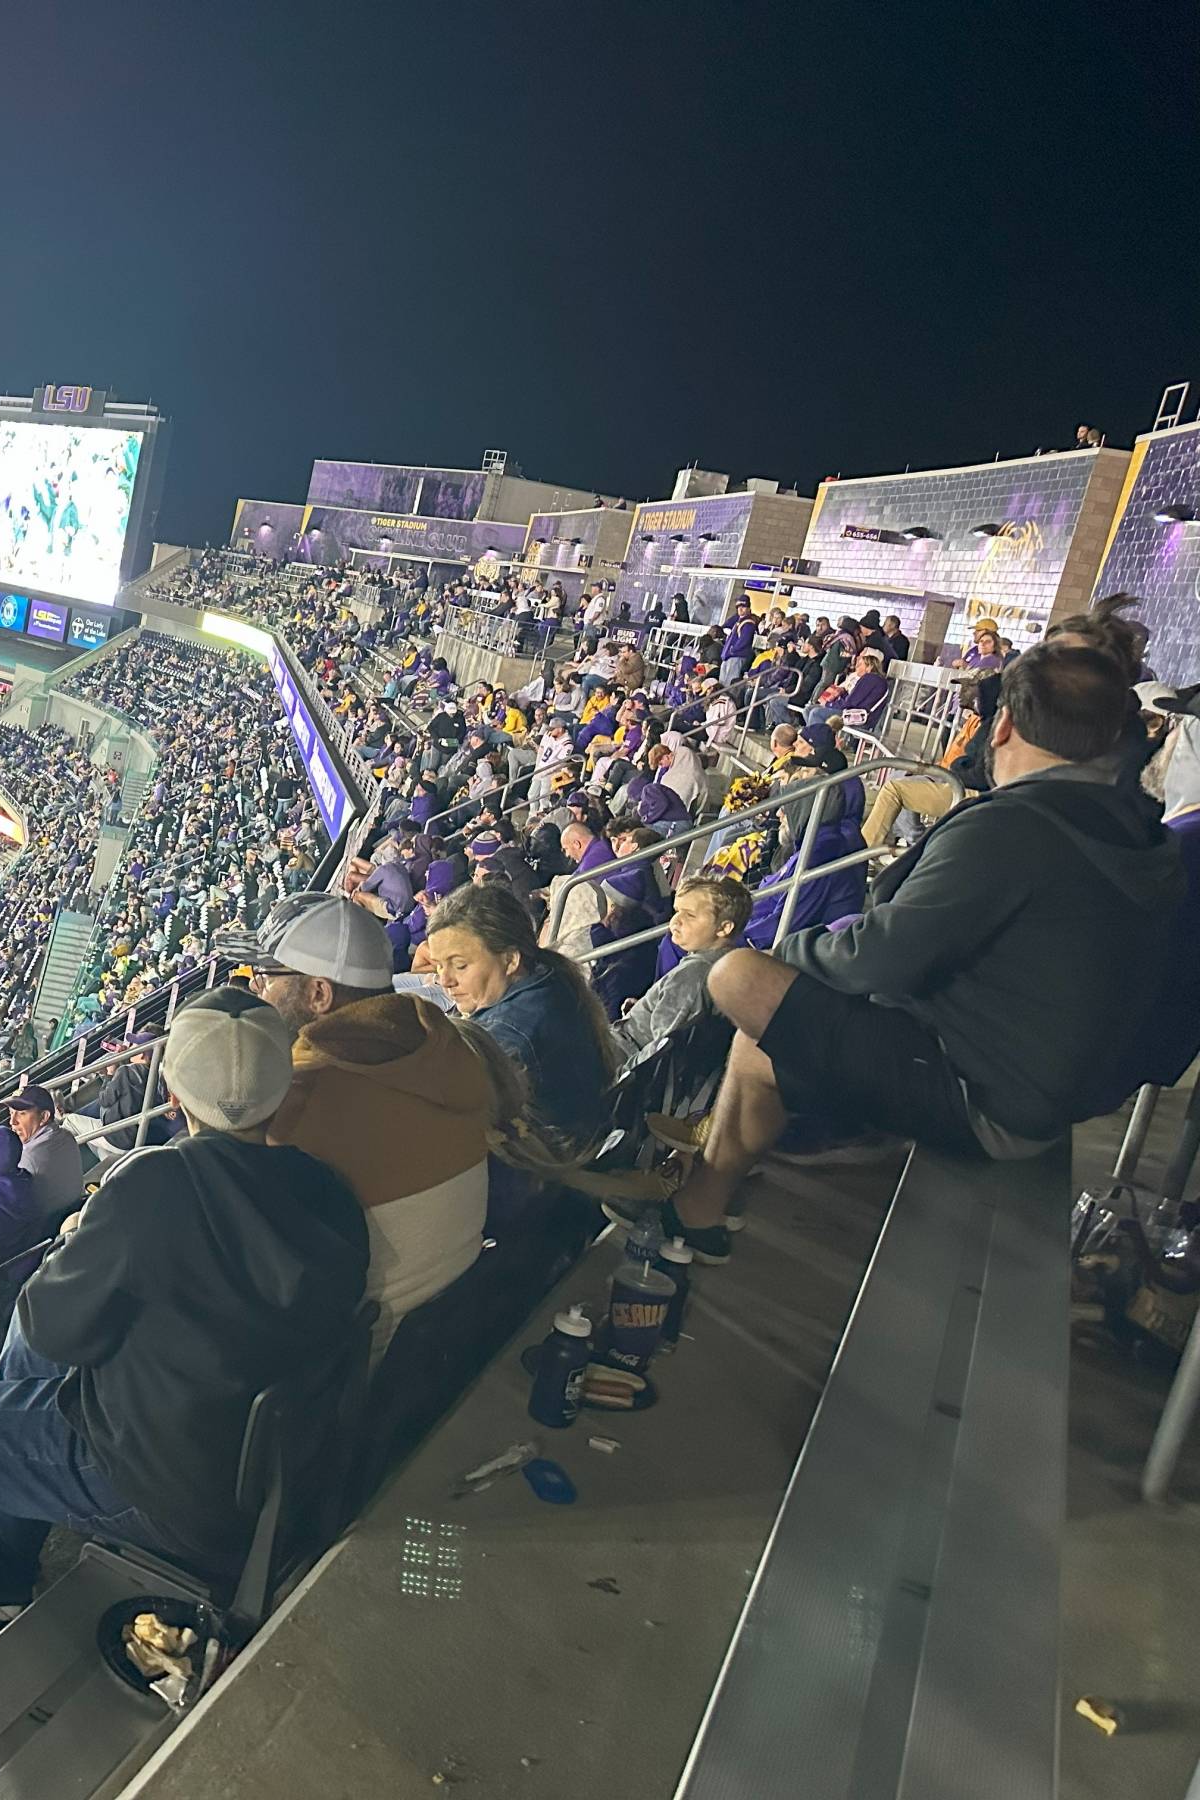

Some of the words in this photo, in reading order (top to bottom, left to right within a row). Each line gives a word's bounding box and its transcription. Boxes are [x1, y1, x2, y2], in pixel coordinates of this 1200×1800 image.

[43, 385, 91, 412] LSU
[376, 518, 396, 527] TIGER
[396, 520, 428, 531] STADIUM
[427, 532, 467, 553] CLUB
[612, 634, 638, 645] LIGHT
[616, 629, 636, 638] BUD
[541, 746, 553, 763] 9
